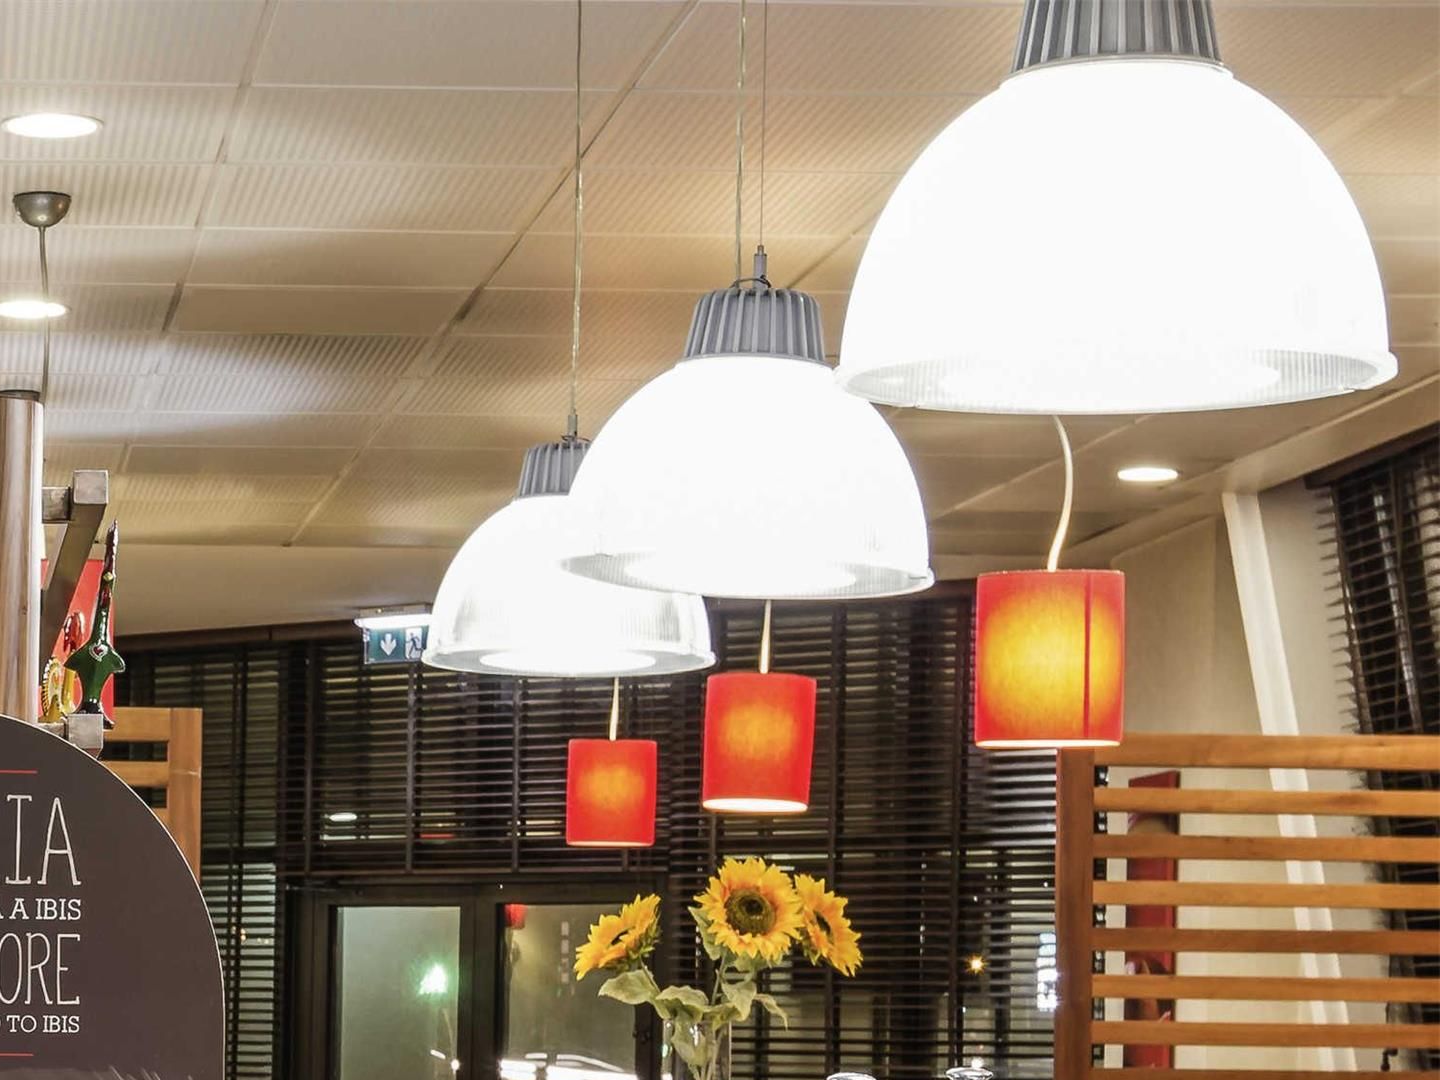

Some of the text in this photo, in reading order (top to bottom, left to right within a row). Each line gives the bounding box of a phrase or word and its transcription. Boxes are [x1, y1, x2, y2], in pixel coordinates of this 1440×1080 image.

[8, 897, 30, 920] A
[35, 898, 82, 921] IBIS
[6, 1014, 37, 1033] TO
[42, 1014, 80, 1034] IBIS
